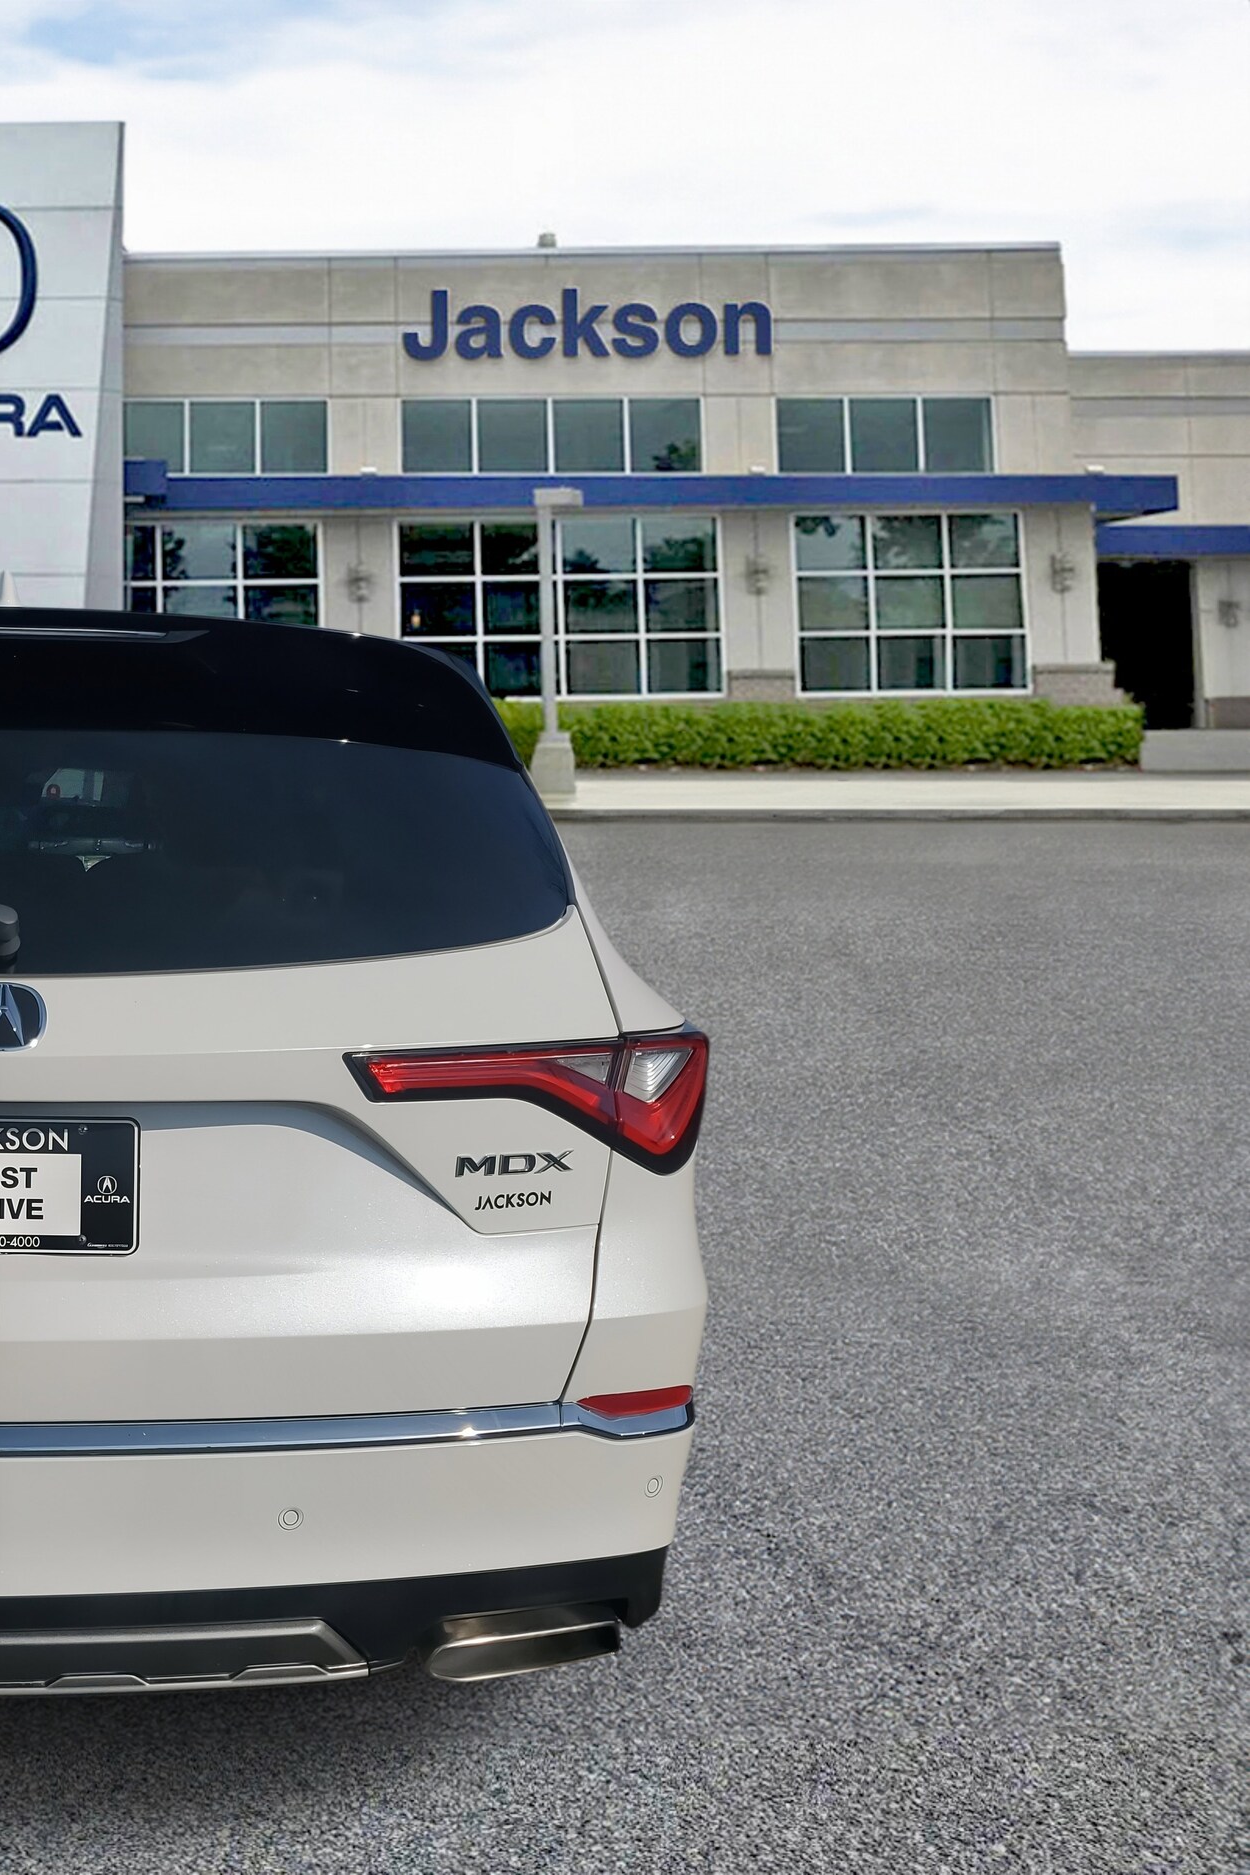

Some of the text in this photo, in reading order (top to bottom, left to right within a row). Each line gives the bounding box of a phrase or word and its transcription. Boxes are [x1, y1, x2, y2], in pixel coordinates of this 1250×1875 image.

[402, 287, 773, 361] Jackson
[454, 1149, 575, 1178] MDX
[83, 1194, 131, 1204] ACURA
[474, 1190, 552, 1211] JACKSON
